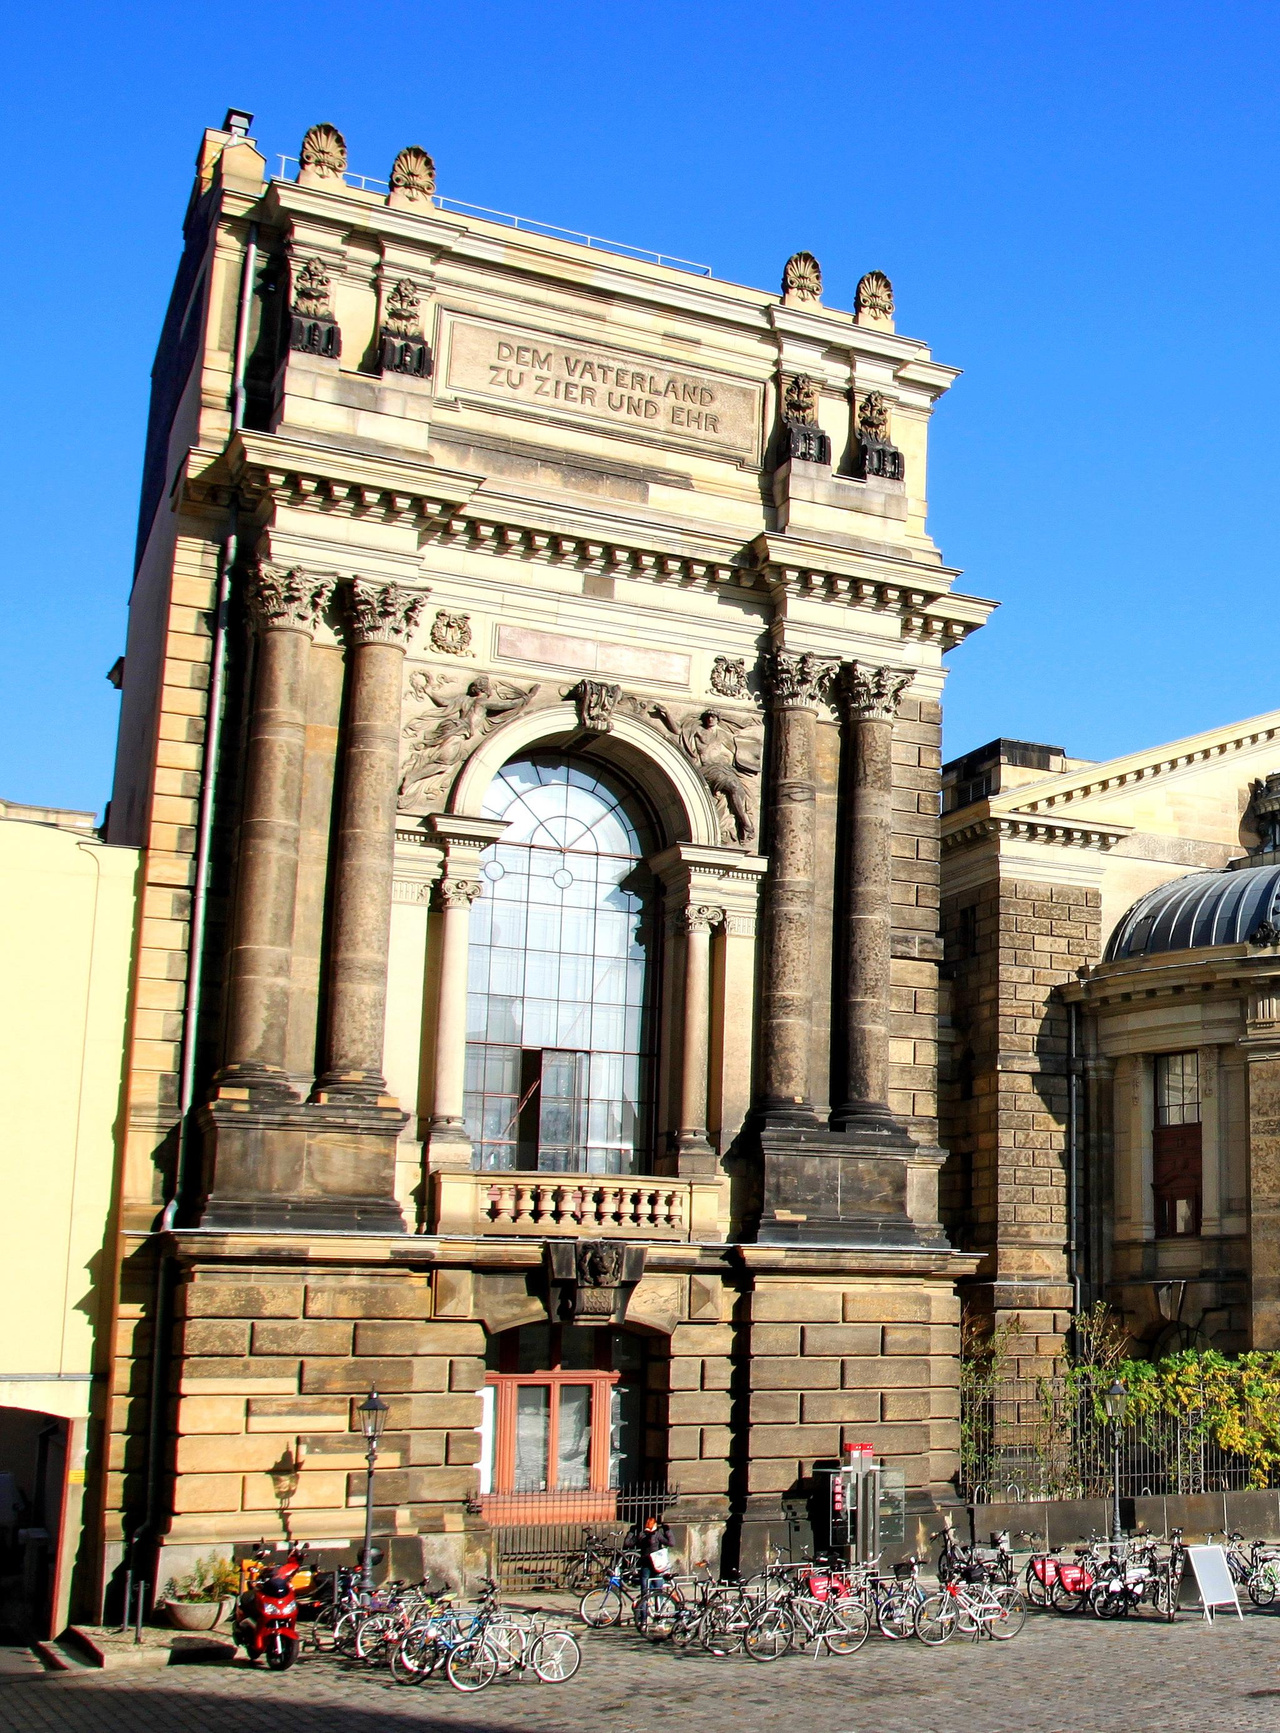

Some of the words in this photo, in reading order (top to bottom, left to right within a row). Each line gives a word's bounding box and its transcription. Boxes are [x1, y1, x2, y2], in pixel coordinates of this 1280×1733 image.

[489, 366, 525, 389] ZU
[535, 375, 597, 407] ZIER
[607, 392, 660, 420] UND
[671, 406, 720, 434] EHR
[497, 341, 552, 371] DEM
[564, 356, 714, 407] VATERLAND
